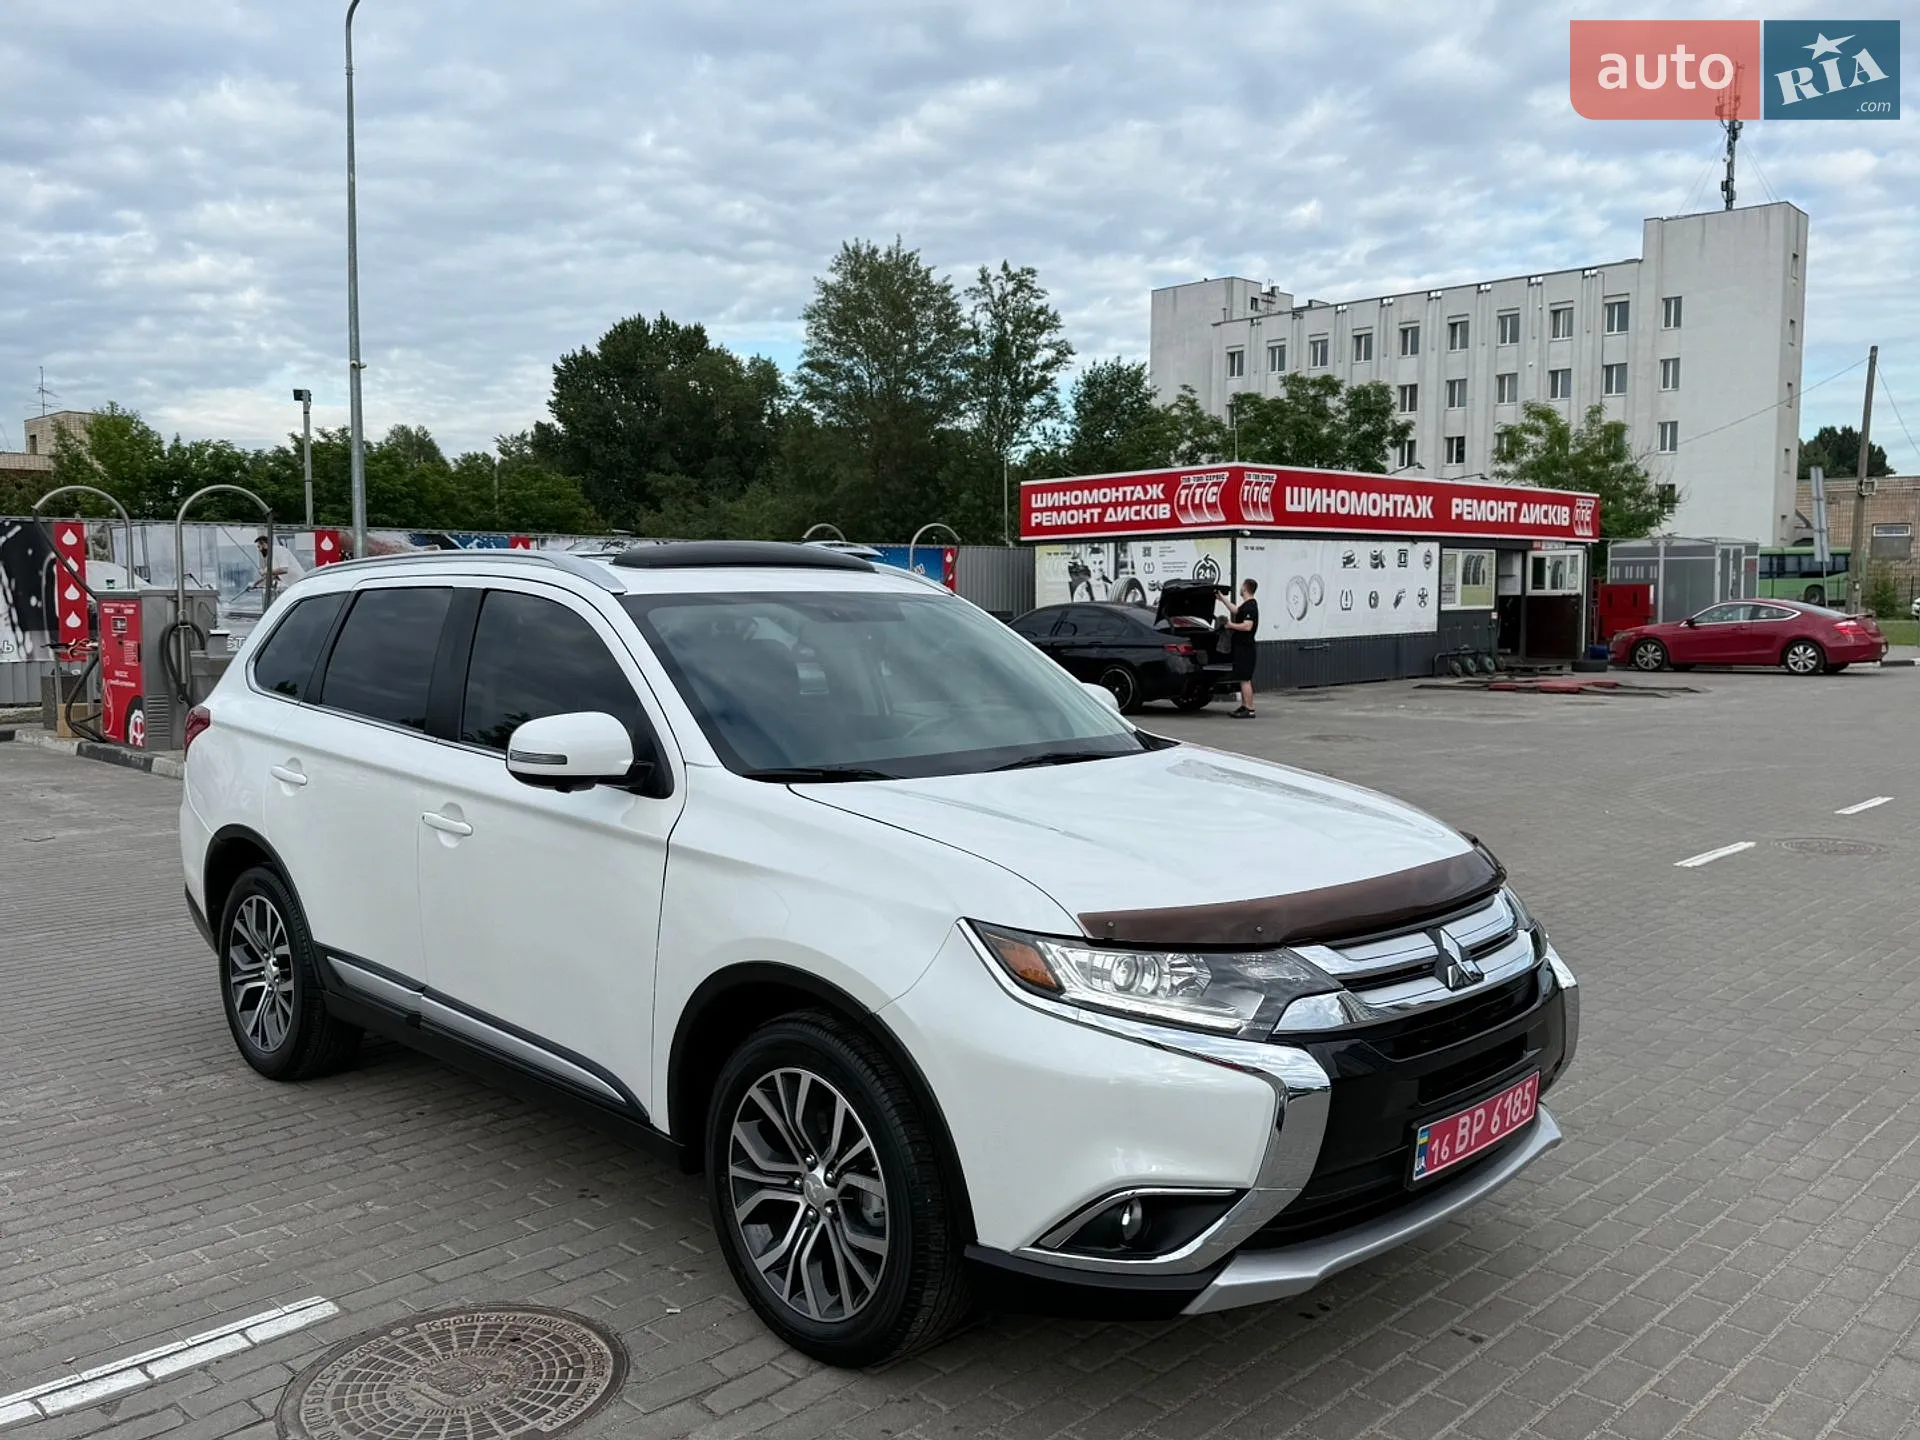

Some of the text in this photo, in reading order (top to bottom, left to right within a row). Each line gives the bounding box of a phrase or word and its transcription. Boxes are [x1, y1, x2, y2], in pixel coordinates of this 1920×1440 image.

[1031, 483, 1165, 508] ШИНОМОНТАЖ
[1285, 486, 1434, 519] ШИНОМОНТАЖ
[1031, 502, 1171, 527] РЕМОНТ ДИСКІВ
[1451, 497, 1570, 527] РЕМОНТ ДИСКІВ
[1431, 1133, 1450, 1165] 16
[1490, 1081, 1532, 1135] 6185
